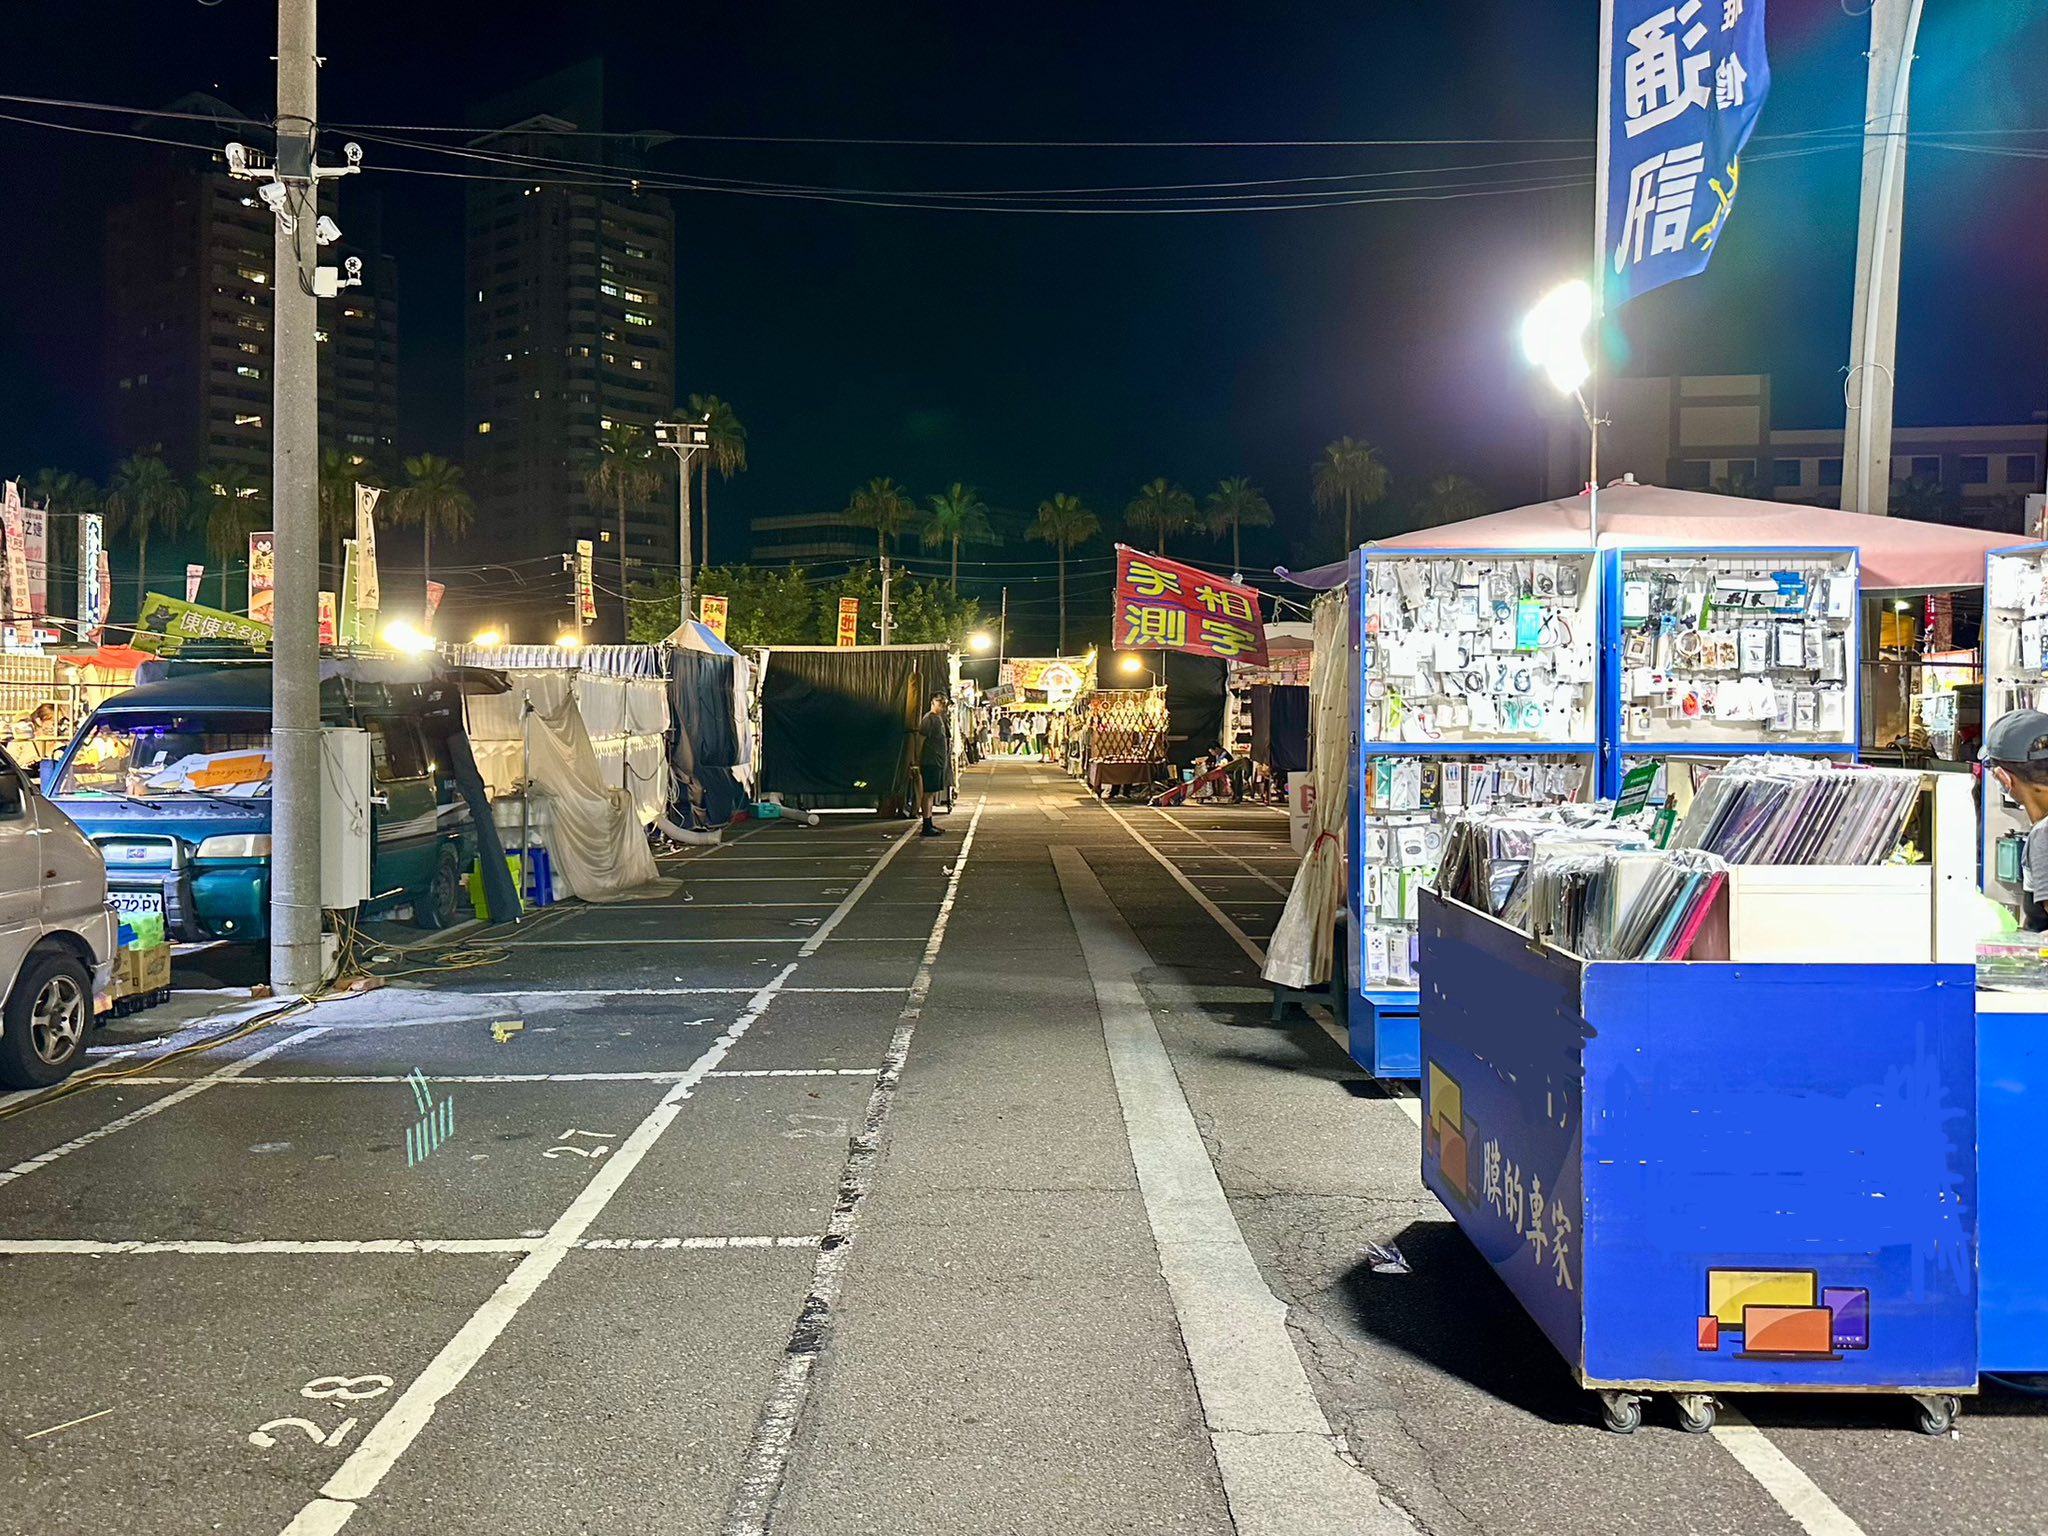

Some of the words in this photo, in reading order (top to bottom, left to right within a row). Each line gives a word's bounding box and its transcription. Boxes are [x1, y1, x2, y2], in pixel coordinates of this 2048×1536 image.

[1126, 561, 1254, 623] 手相
[1124, 604, 1257, 656] 測字
[543, 1128, 616, 1158] 27
[1483, 1138, 1573, 1289] 膜的專家
[248, 1373, 394, 1448] 28
